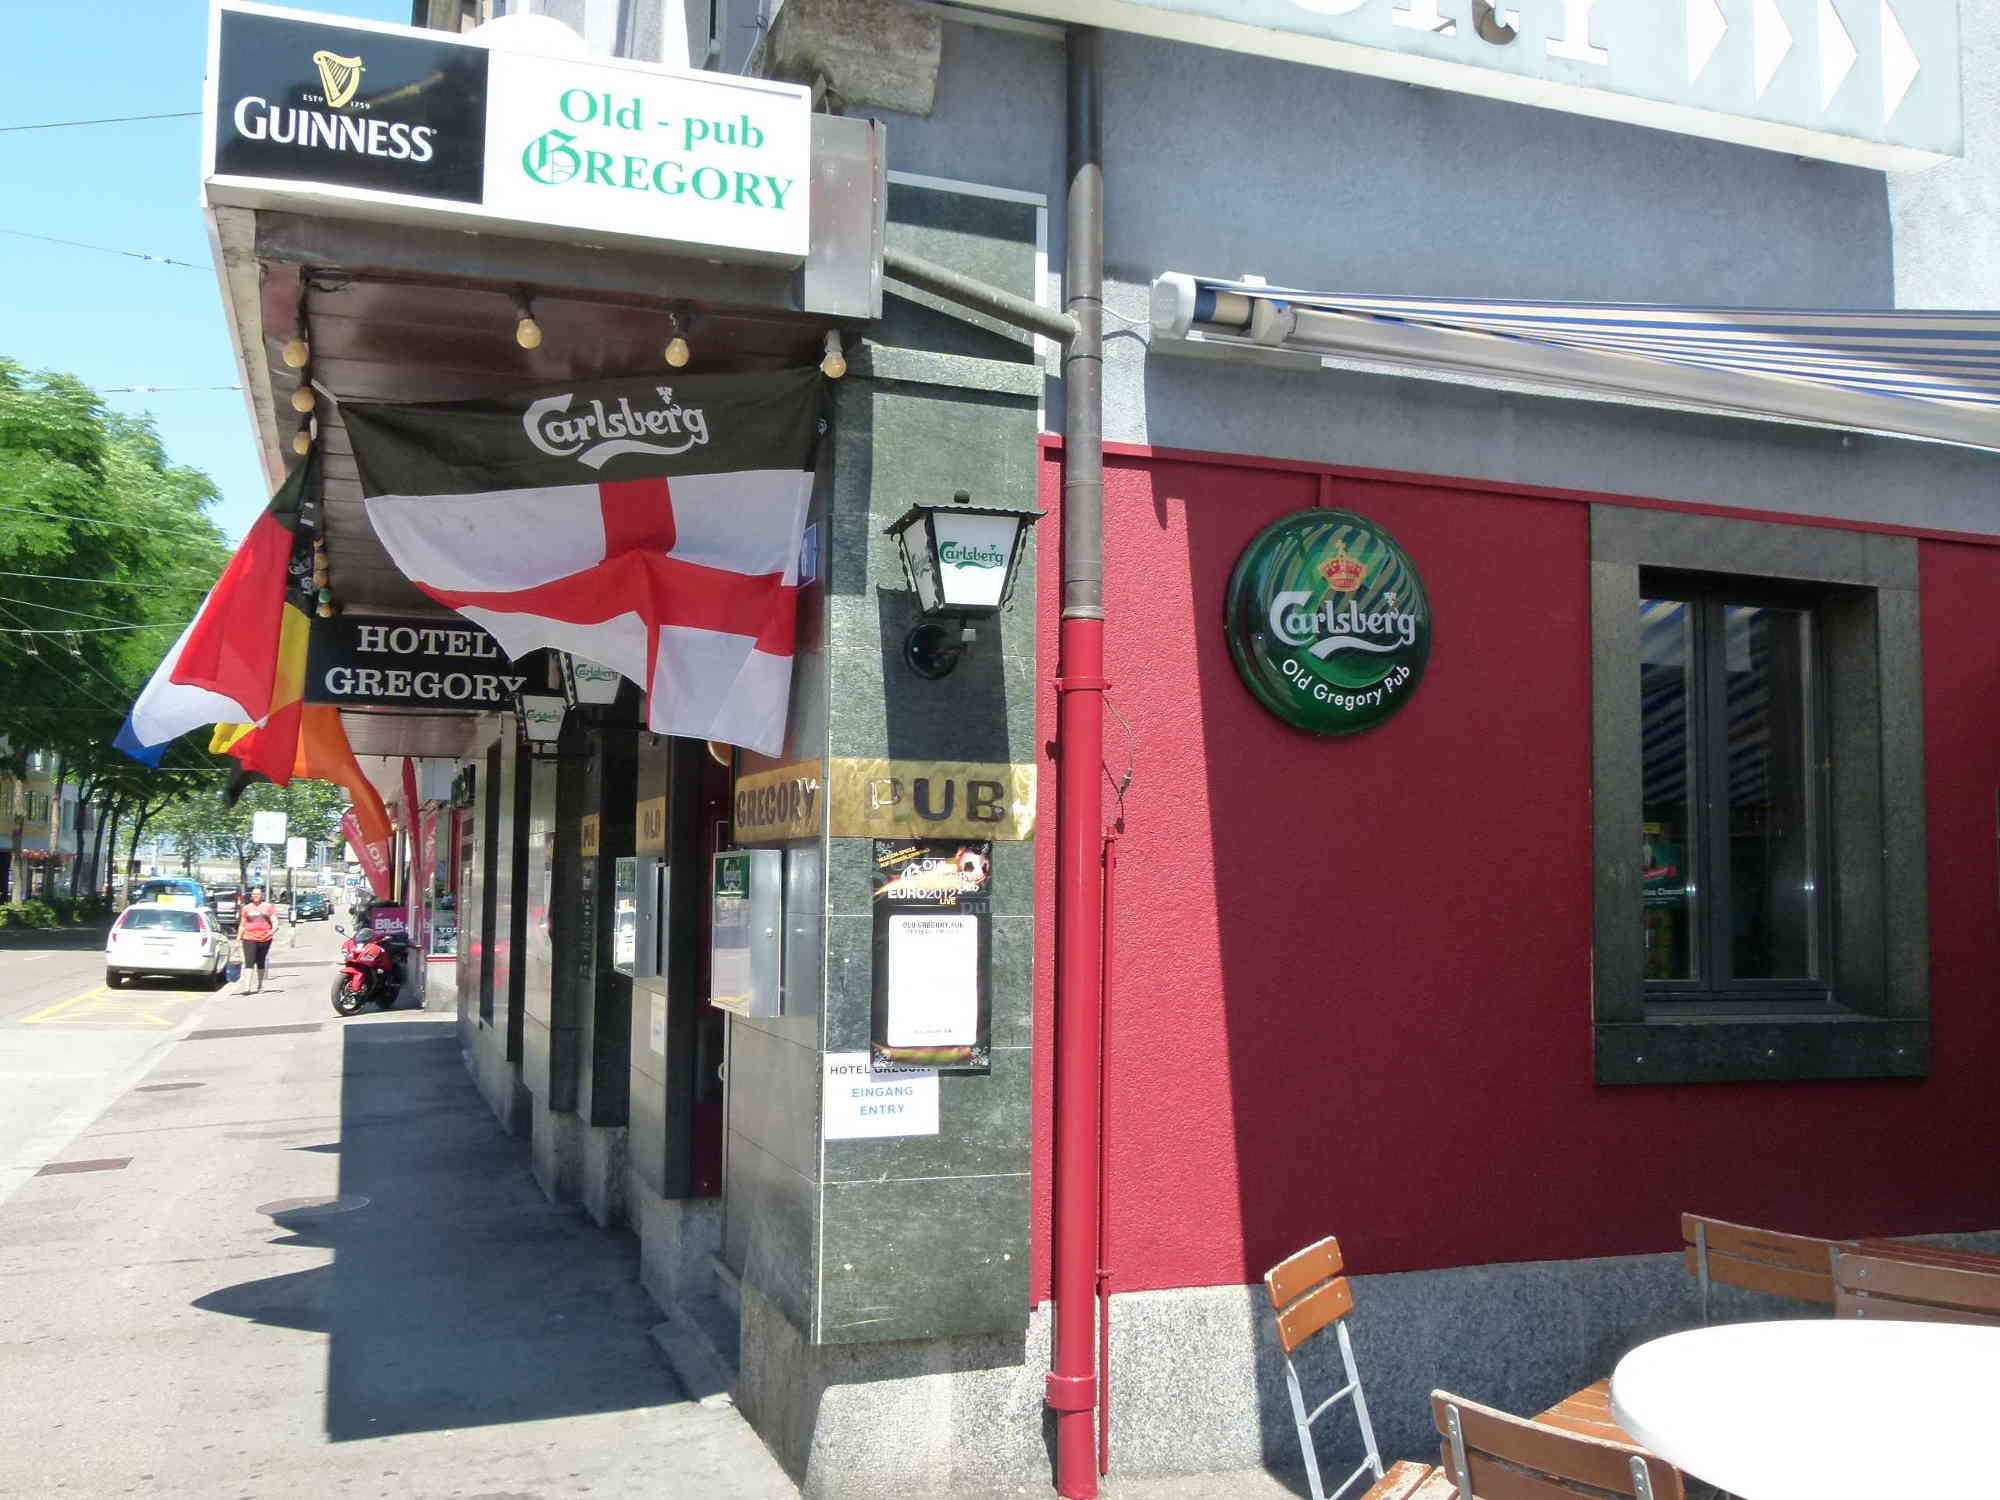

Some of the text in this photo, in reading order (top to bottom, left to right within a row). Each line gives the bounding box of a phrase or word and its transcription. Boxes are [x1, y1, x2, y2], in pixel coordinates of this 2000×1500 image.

[234, 96, 433, 162] GUINNESS
[560, 88, 643, 131] Old
[683, 114, 764, 151] pub
[522, 129, 793, 210] GREGORY
[523, 386, 709, 469] Carlsberg
[939, 541, 1004, 570] Carlsberg
[357, 625, 498, 658] HOTEL
[1269, 590, 1416, 659] Carlsberg
[325, 667, 527, 701] GREGORY
[1282, 659, 1410, 711] Old Gregory Pub
[736, 777, 1006, 828] GREGORY PUB
[888, 888, 957, 899] EURO2012
[830, 1064, 870, 1075] HOTEL
[851, 1087, 914, 1097] EINGANG
[860, 1104, 905, 1115] ENTRY
